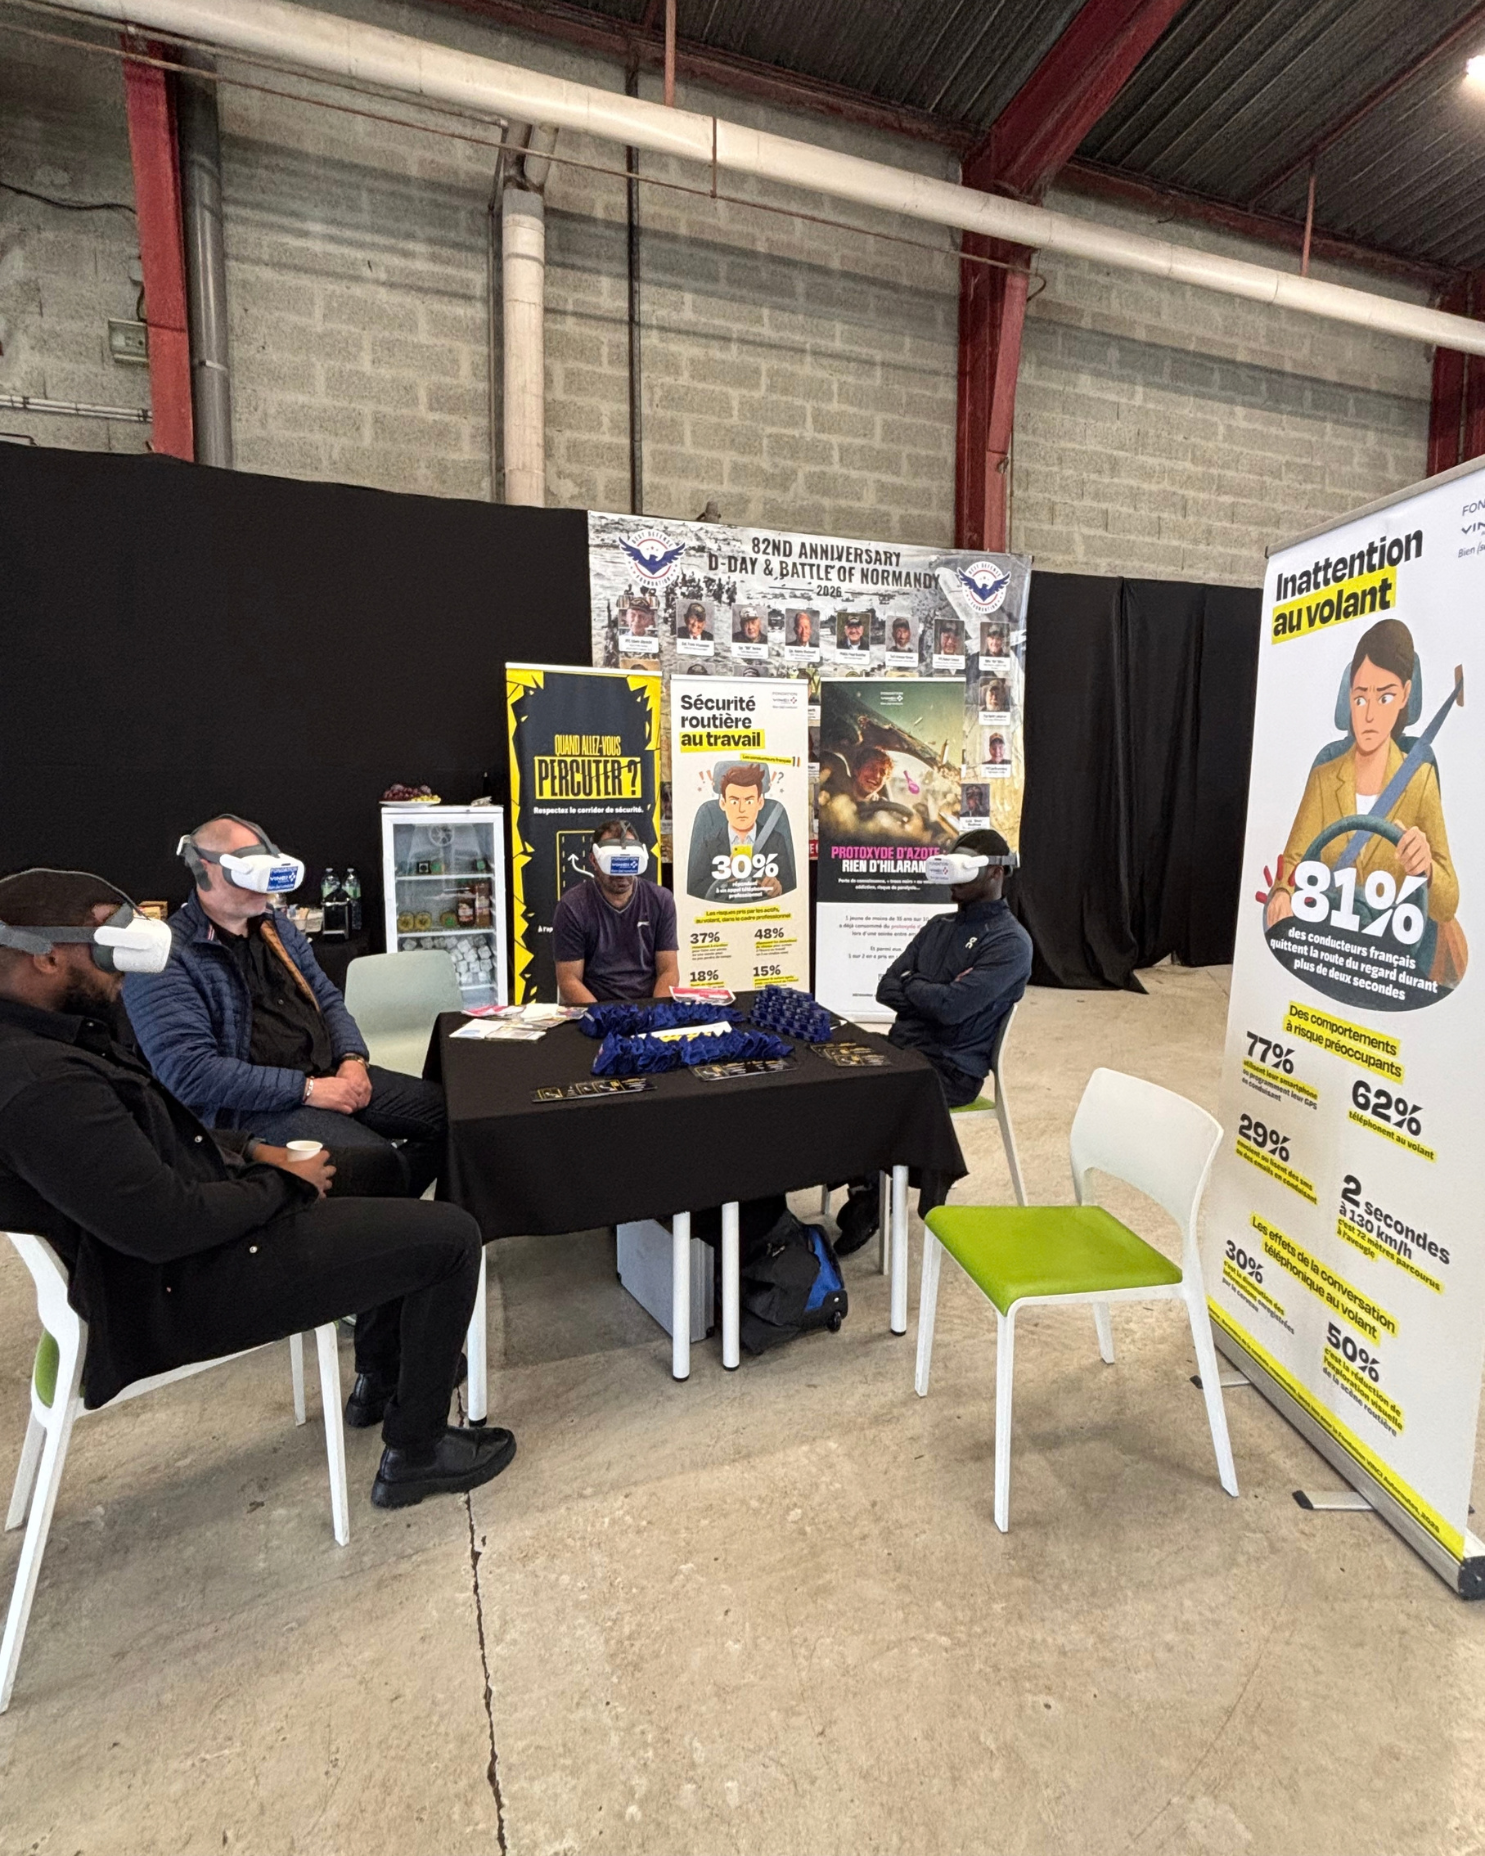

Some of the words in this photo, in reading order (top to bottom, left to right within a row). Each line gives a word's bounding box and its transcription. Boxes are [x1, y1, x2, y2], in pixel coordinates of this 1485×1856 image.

[631, 531, 645, 544] BEST
[648, 531, 673, 547] DEFENSE
[751, 536, 793, 558] 82ND
[798, 541, 901, 567] ANNIVERSARY
[708, 553, 758, 575] D-DAY
[763, 558, 773, 576] &
[779, 560, 832, 581] BATTLE
[837, 565, 855, 583] OF
[860, 567, 940, 589] NORMANDY
[967, 562, 980, 575] BEST
[1275, 529, 1423, 602] Inattention
[816, 584, 843, 598] 2026
[1273, 607, 1303, 636] au
[1307, 577, 1392, 628] volant
[680, 694, 756, 711] Sécurité
[681, 713, 752, 729] routière
[554, 734, 580, 755] QUAND
[581, 735, 621, 756] ALLEZ-VOUS
[681, 733, 703, 746] au
[706, 732, 761, 747] travail
[537, 759, 623, 797] PERCUTER
[627, 759, 638, 796] ?
[533, 806, 569, 815] Respectez
[577, 806, 604, 814] corridor
[615, 805, 644, 814] sécurité.
[711, 853, 779, 880] 30%
[831, 846, 894, 859] PROTOXYDE
[842, 859, 867, 872] RIEN
[1291, 859, 1428, 945] 81%
[690, 931, 720, 944] 37%
[754, 927, 784, 939] 48%
[1288, 926, 1306, 940] des
[1307, 932, 1368, 957] conducteurs
[1369, 946, 1416, 969] français
[690, 969, 719, 982] 18%
[753, 964, 781, 977] 15%
[1270, 938, 1308, 956] quittent
[1309, 946, 1318, 958] la
[1320, 951, 1345, 966] route
[1345, 957, 1358, 970] du
[1360, 962, 1397, 981] regard
[1398, 970, 1438, 993] durant
[1293, 957, 1315, 973] plus
[1316, 963, 1328, 976] de
[1328, 967, 1351, 984] deux
[1352, 976, 1406, 1001] secondes
[1286, 1019, 1293, 1032] à
[1293, 1023, 1324, 1044] risque
[1324, 1039, 1402, 1078] préoccupants
[1289, 1004, 1309, 1021] Des
[1310, 1014, 1397, 1056] comportements
[1246, 1030, 1295, 1074] 77%
[1242, 1068, 1249, 1076] ou
[1249, 1072, 1290, 1096] programment
[1291, 1090, 1304, 1103] leur
[1304, 1098, 1317, 1110] GPS
[1242, 1077, 1248, 1085] en
[1248, 1081, 1281, 1102] conduisant
[1243, 1060, 1266, 1075] utilisent
[1266, 1069, 1279, 1081] leur
[1280, 1077, 1318, 1100] smartphone
[1352, 1079, 1424, 1136] 62%
[1238, 1113, 1291, 1162] 29%
[1349, 1110, 1395, 1139] téléphonent
[1395, 1135, 1406, 1146] au
[1407, 1140, 1434, 1160] volant
[1243, 1152, 1254, 1163] des
[1254, 1160, 1274, 1175] emails
[1274, 1172, 1282, 1181] en
[1282, 1178, 1317, 1205] conduisant
[1269, 1158, 1287, 1174] lisent
[1288, 1170, 1299, 1181] des
[1299, 1178, 1313, 1191] sms
[1339, 1200, 1347, 1217] à
[1349, 1209, 1374, 1233] 130
[1376, 1225, 1412, 1260] km/h
[1341, 1174, 1362, 1209] 2
[1364, 1201, 1450, 1265] secondes
[1225, 1239, 1264, 1284] 30%
[1337, 1225, 1342, 1236] à
[1342, 1230, 1375, 1258] l'aveugle
[1338, 1218, 1356, 1234] c'est
[1356, 1229, 1366, 1239] 72
[1367, 1237, 1395, 1260] mètres
[1396, 1256, 1440, 1291] parcourus
[1252, 1216, 1268, 1236] Les
[1268, 1229, 1296, 1256] effets
[1297, 1251, 1310, 1267] de
[1310, 1257, 1319, 1275] la
[1320, 1270, 1396, 1334] conversation
[1264, 1241, 1324, 1297] téléphonique
[1326, 1291, 1340, 1310] au
[1341, 1302, 1378, 1340] volant
[1257, 1299, 1294, 1335] enregistrées
[1273, 1302, 1284, 1316] des
[1326, 1321, 1380, 1383] 50%
[1322, 1366, 1331, 1378] de
[1332, 1374, 1340, 1386] la
[1340, 1382, 1363, 1407] scène
[1363, 1404, 1397, 1437] routière
[1323, 1355, 1370, 1402] l'exploration
[1370, 1398, 1403, 1431] visuelle
[1324, 1347, 1342, 1363] c'est
[1342, 1360, 1349, 1372] la
[1350, 1369, 1389, 1406] réduction
[1390, 1402, 1401, 1417] de
